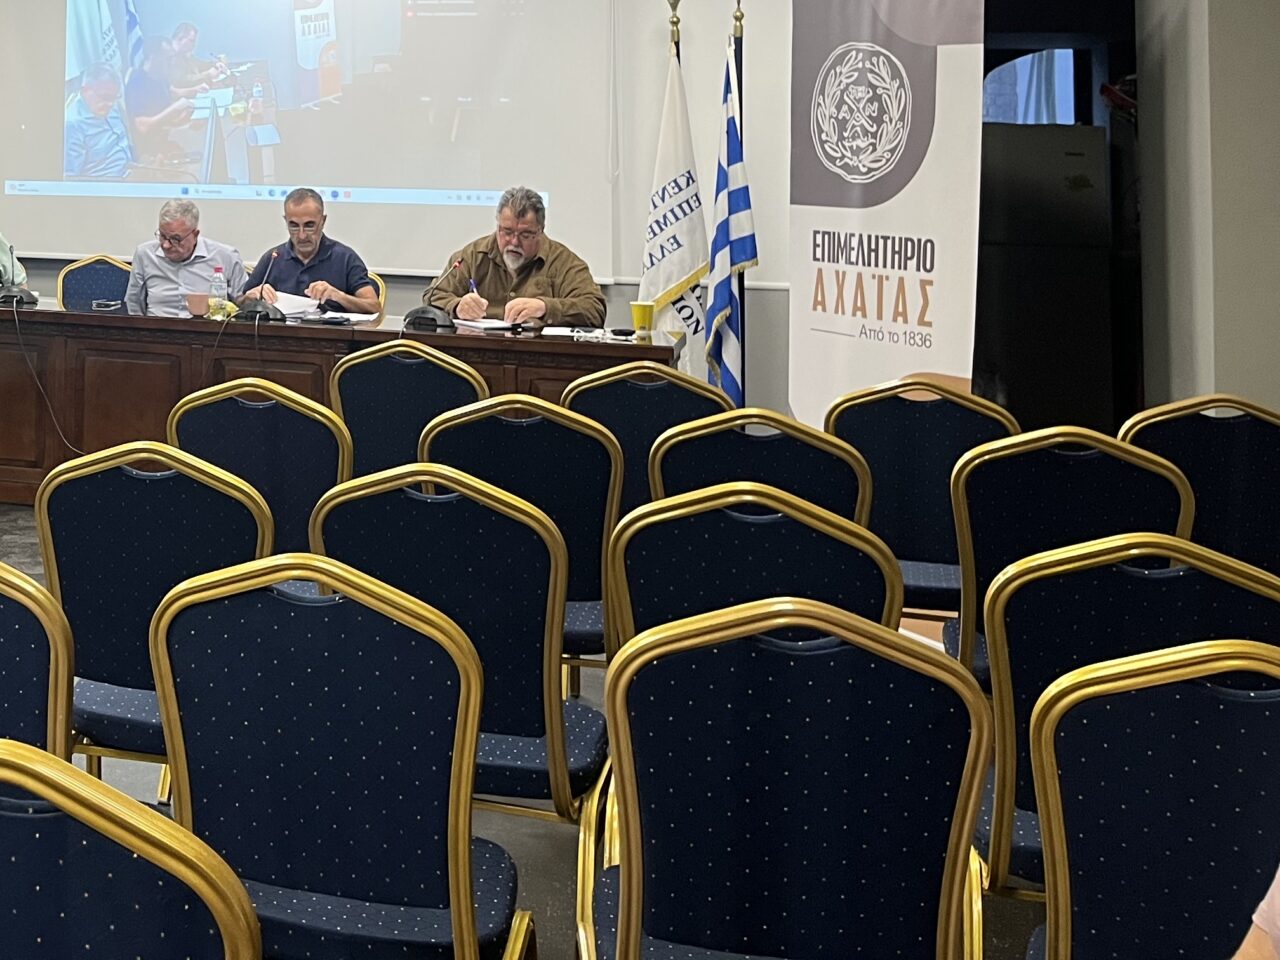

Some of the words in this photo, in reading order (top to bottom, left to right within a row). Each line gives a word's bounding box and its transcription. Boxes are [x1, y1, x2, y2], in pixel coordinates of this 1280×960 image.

[812, 229, 936, 274] ΕΠΙΜΕΛΗΤΗΡΙΟ
[858, 323, 884, 342] Από
[887, 331, 899, 344] το
[902, 330, 933, 349] 1836
